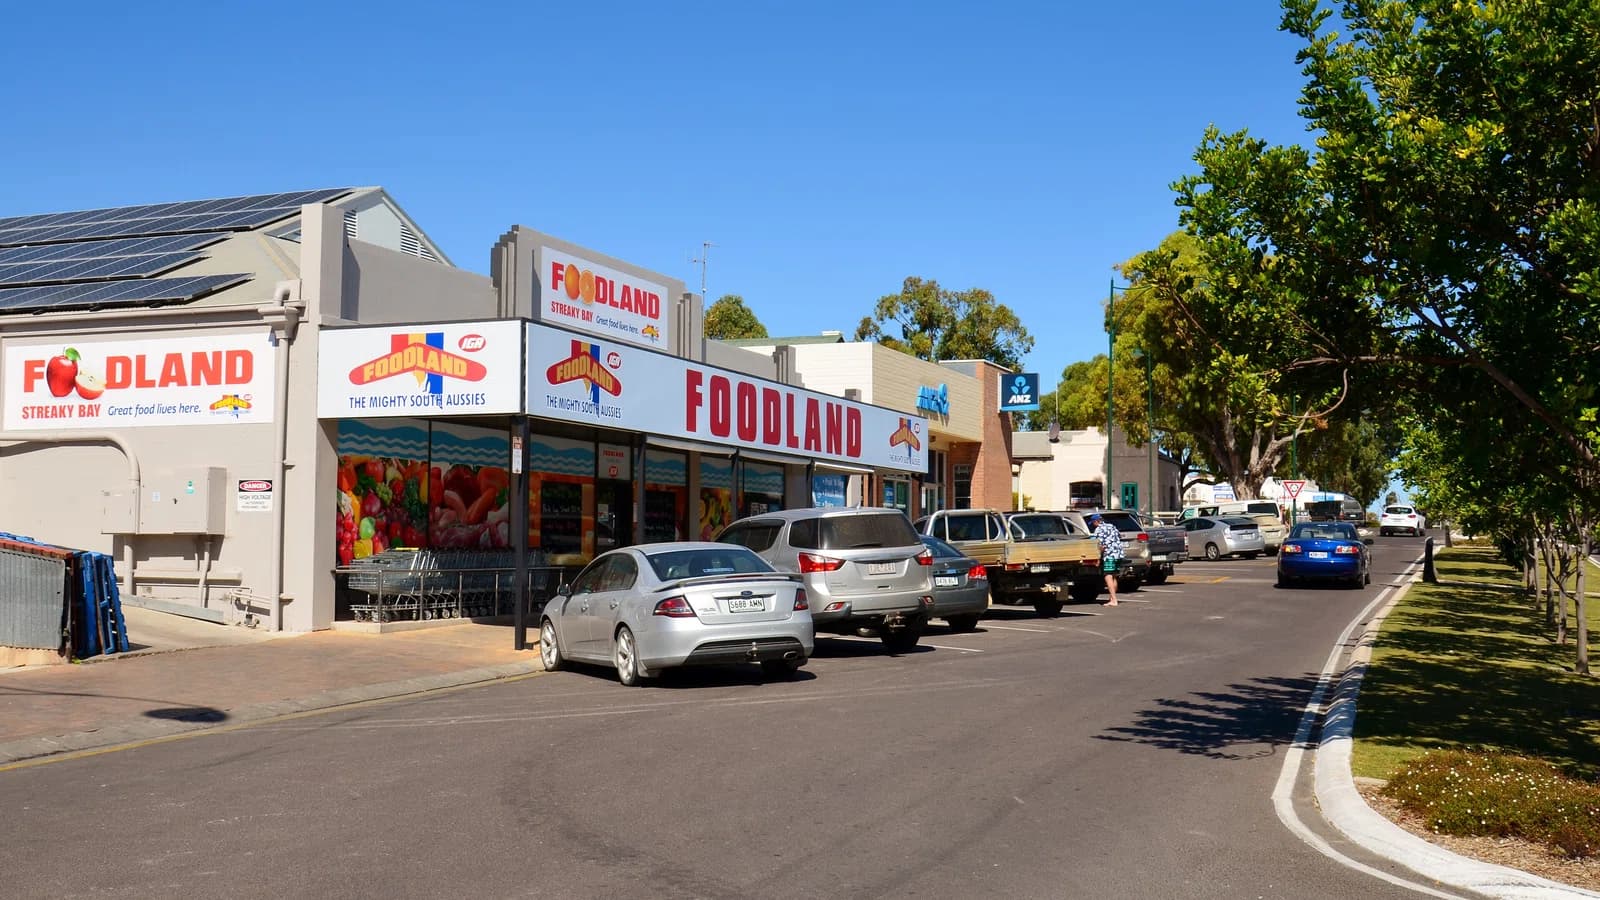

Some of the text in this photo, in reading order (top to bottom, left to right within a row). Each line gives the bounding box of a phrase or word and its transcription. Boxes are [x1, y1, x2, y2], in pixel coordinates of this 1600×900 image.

[551, 301, 594, 323] STREAKY BAY
[596, 315, 608, 327] Great
[608, 318, 619, 329] food
[619, 321, 629, 332] lives
[461, 337, 485, 350] IGA
[363, 346, 468, 382] FOODLAND
[556, 354, 613, 392] FOODLAND
[349, 393, 486, 408] THE MIGHTY SOUTH AUSSIES
[547, 395, 622, 419] THE MIGHTY SOUTH AUSSIES
[1008, 394, 1031, 404] ANZ
[22, 403, 101, 420] STREAKY BAY
[108, 404, 133, 416] Great
[134, 403, 155, 418] food
[156, 403, 177, 415] lives
[179, 402, 202, 414] here.
[686, 368, 862, 458] FOODLAND
